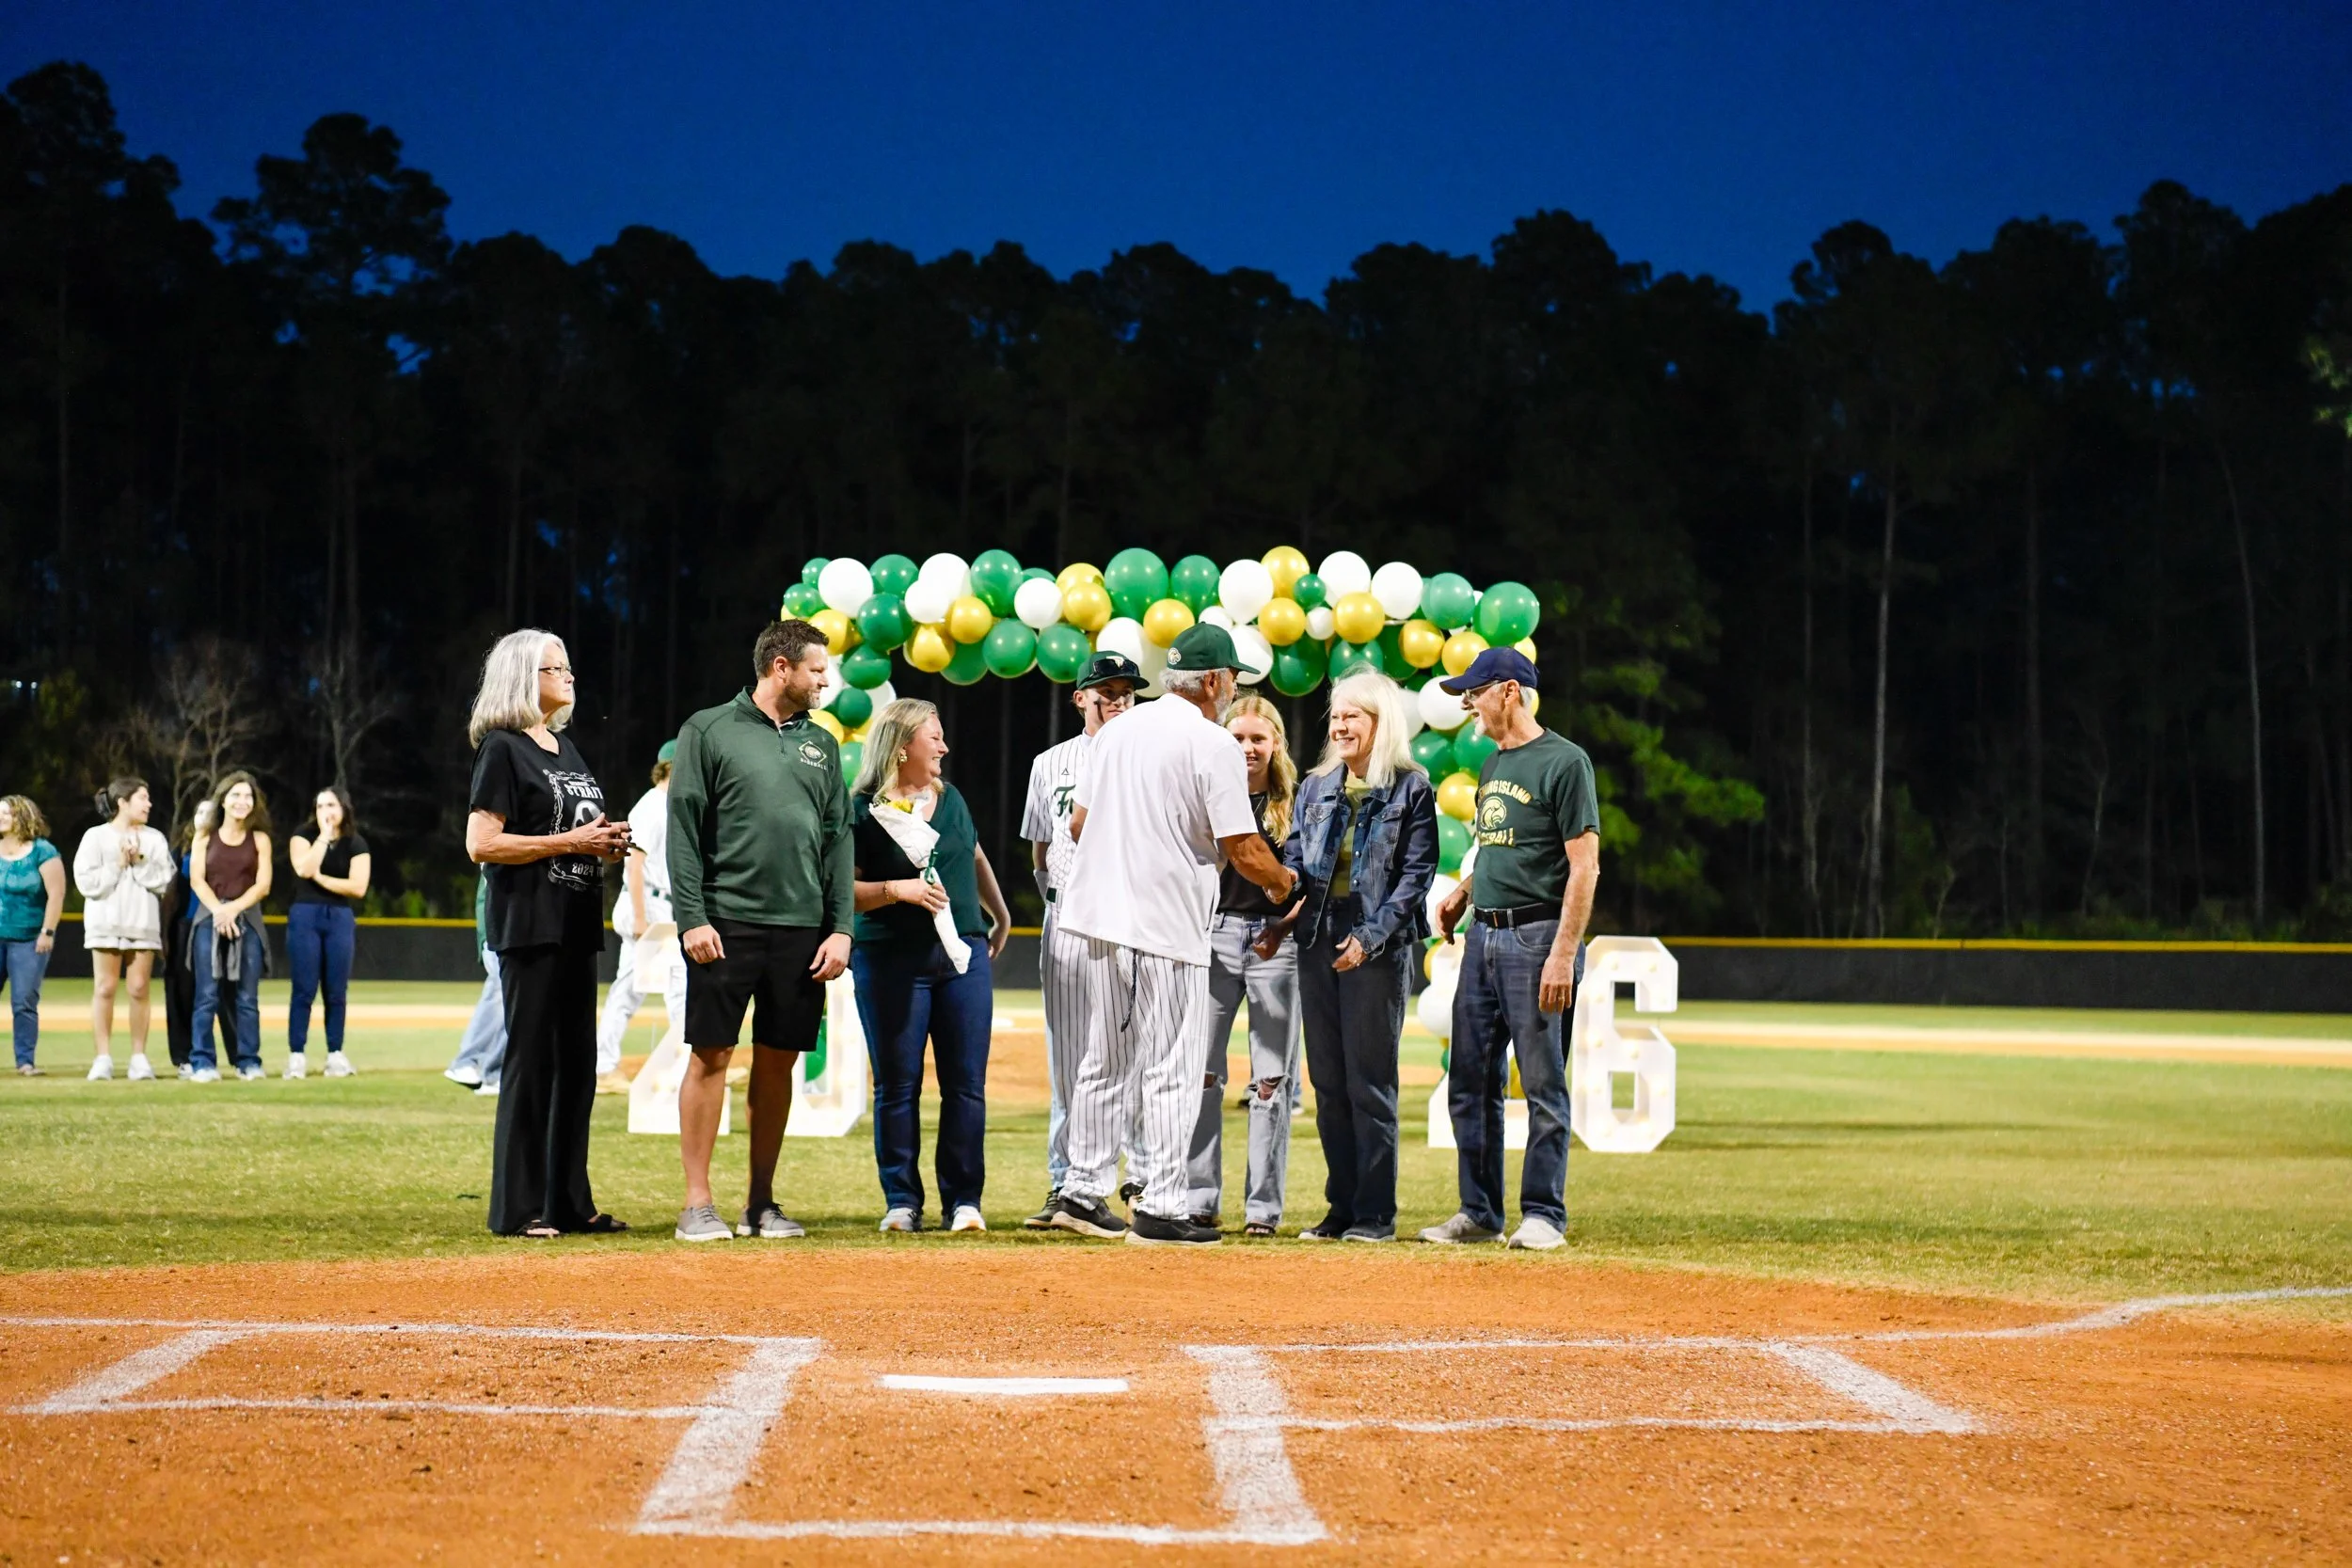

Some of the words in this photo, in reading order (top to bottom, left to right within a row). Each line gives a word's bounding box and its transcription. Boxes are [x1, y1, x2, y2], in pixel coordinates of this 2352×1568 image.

[564, 784, 603, 799] STRAIT
[1499, 780, 1532, 804] ISLAND
[571, 862, 595, 877] 2024
